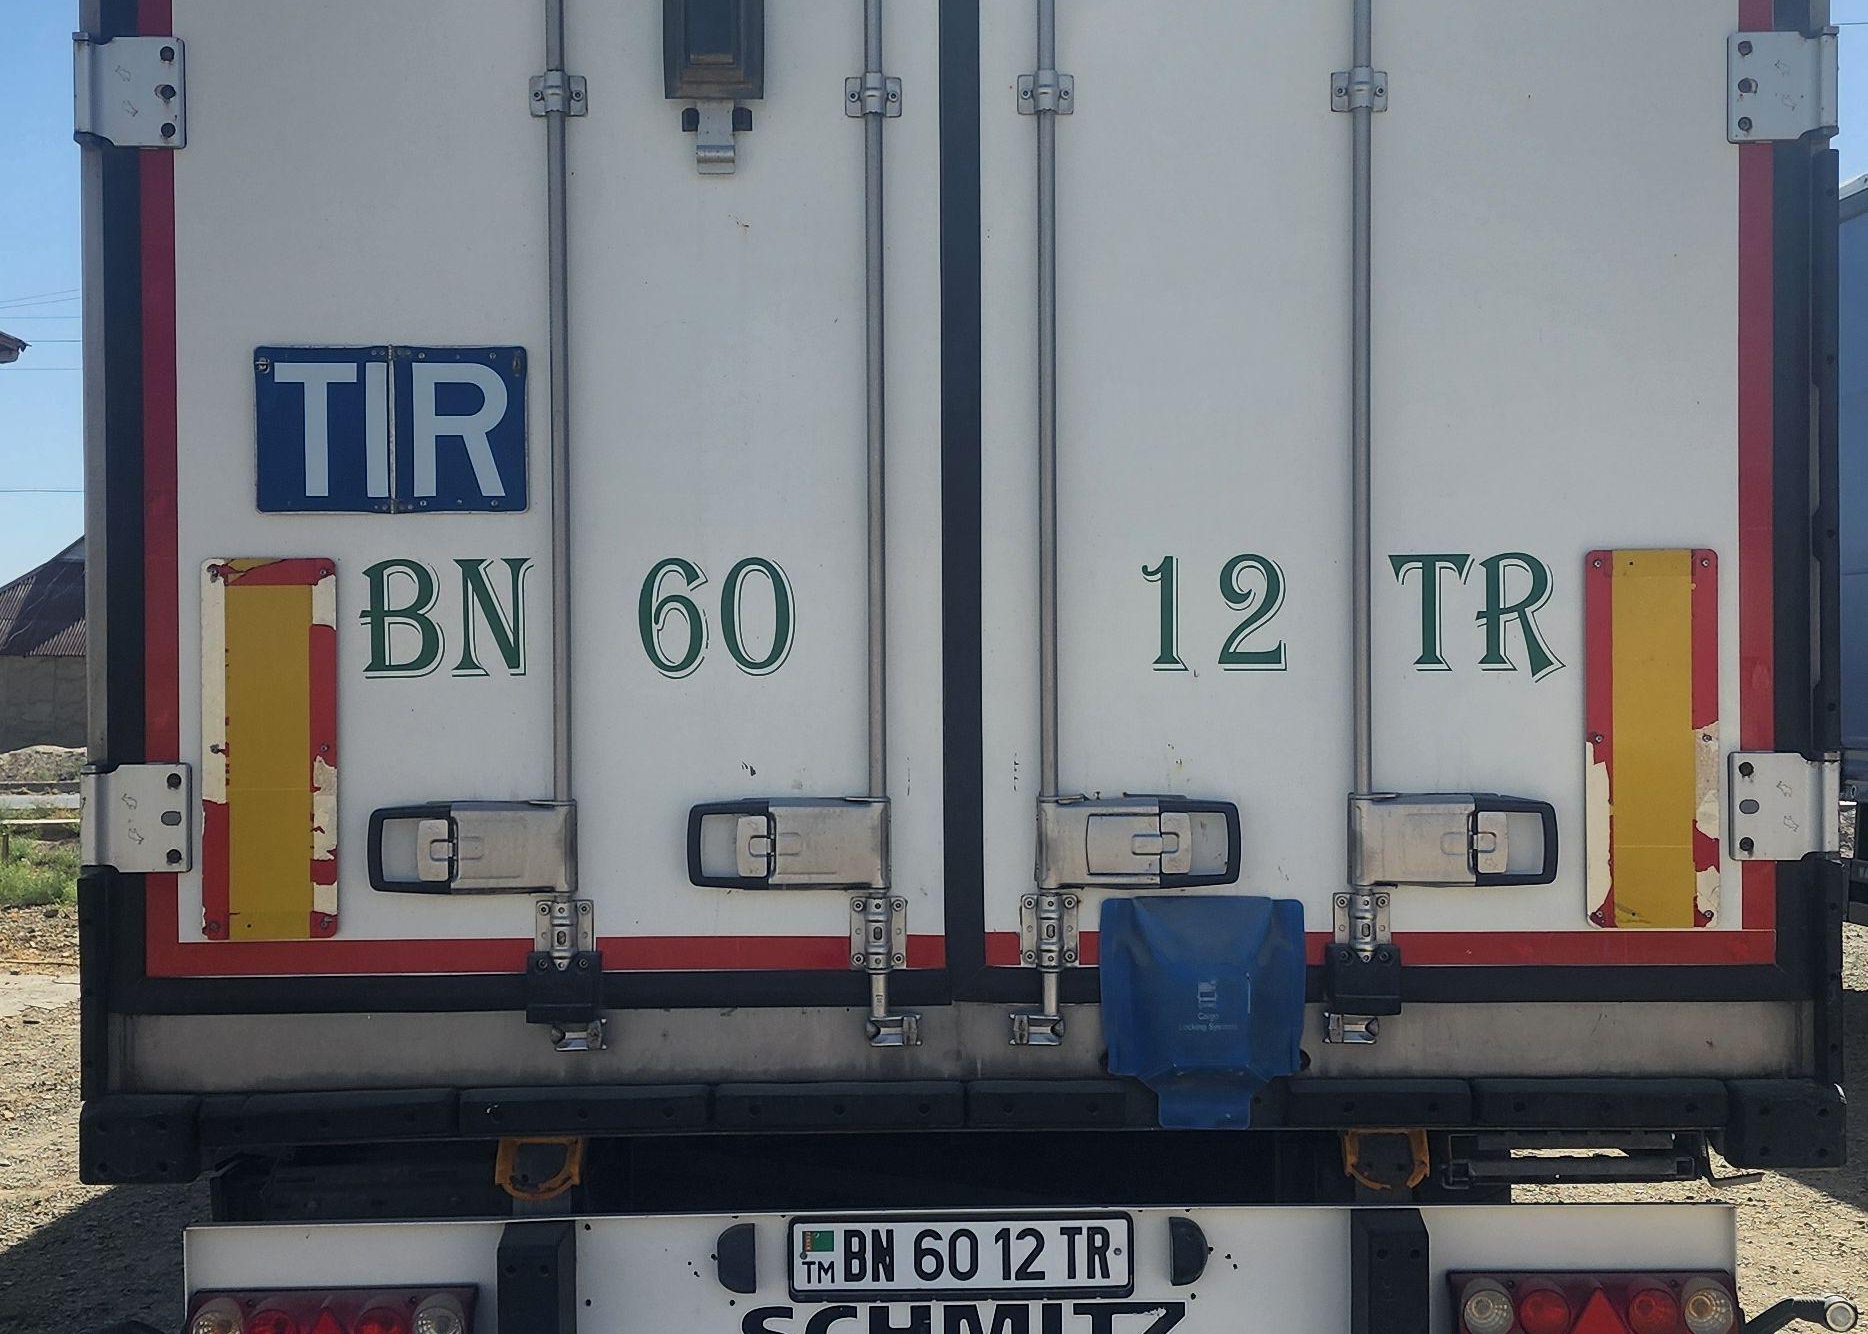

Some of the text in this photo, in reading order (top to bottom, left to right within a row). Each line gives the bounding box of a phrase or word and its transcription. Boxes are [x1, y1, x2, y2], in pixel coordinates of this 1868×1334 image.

[274, 362, 508, 497] TIR
[359, 552, 1566, 683] BN 60 12 TR
[802, 1227, 1111, 1284] TM BN 60 12 TR
